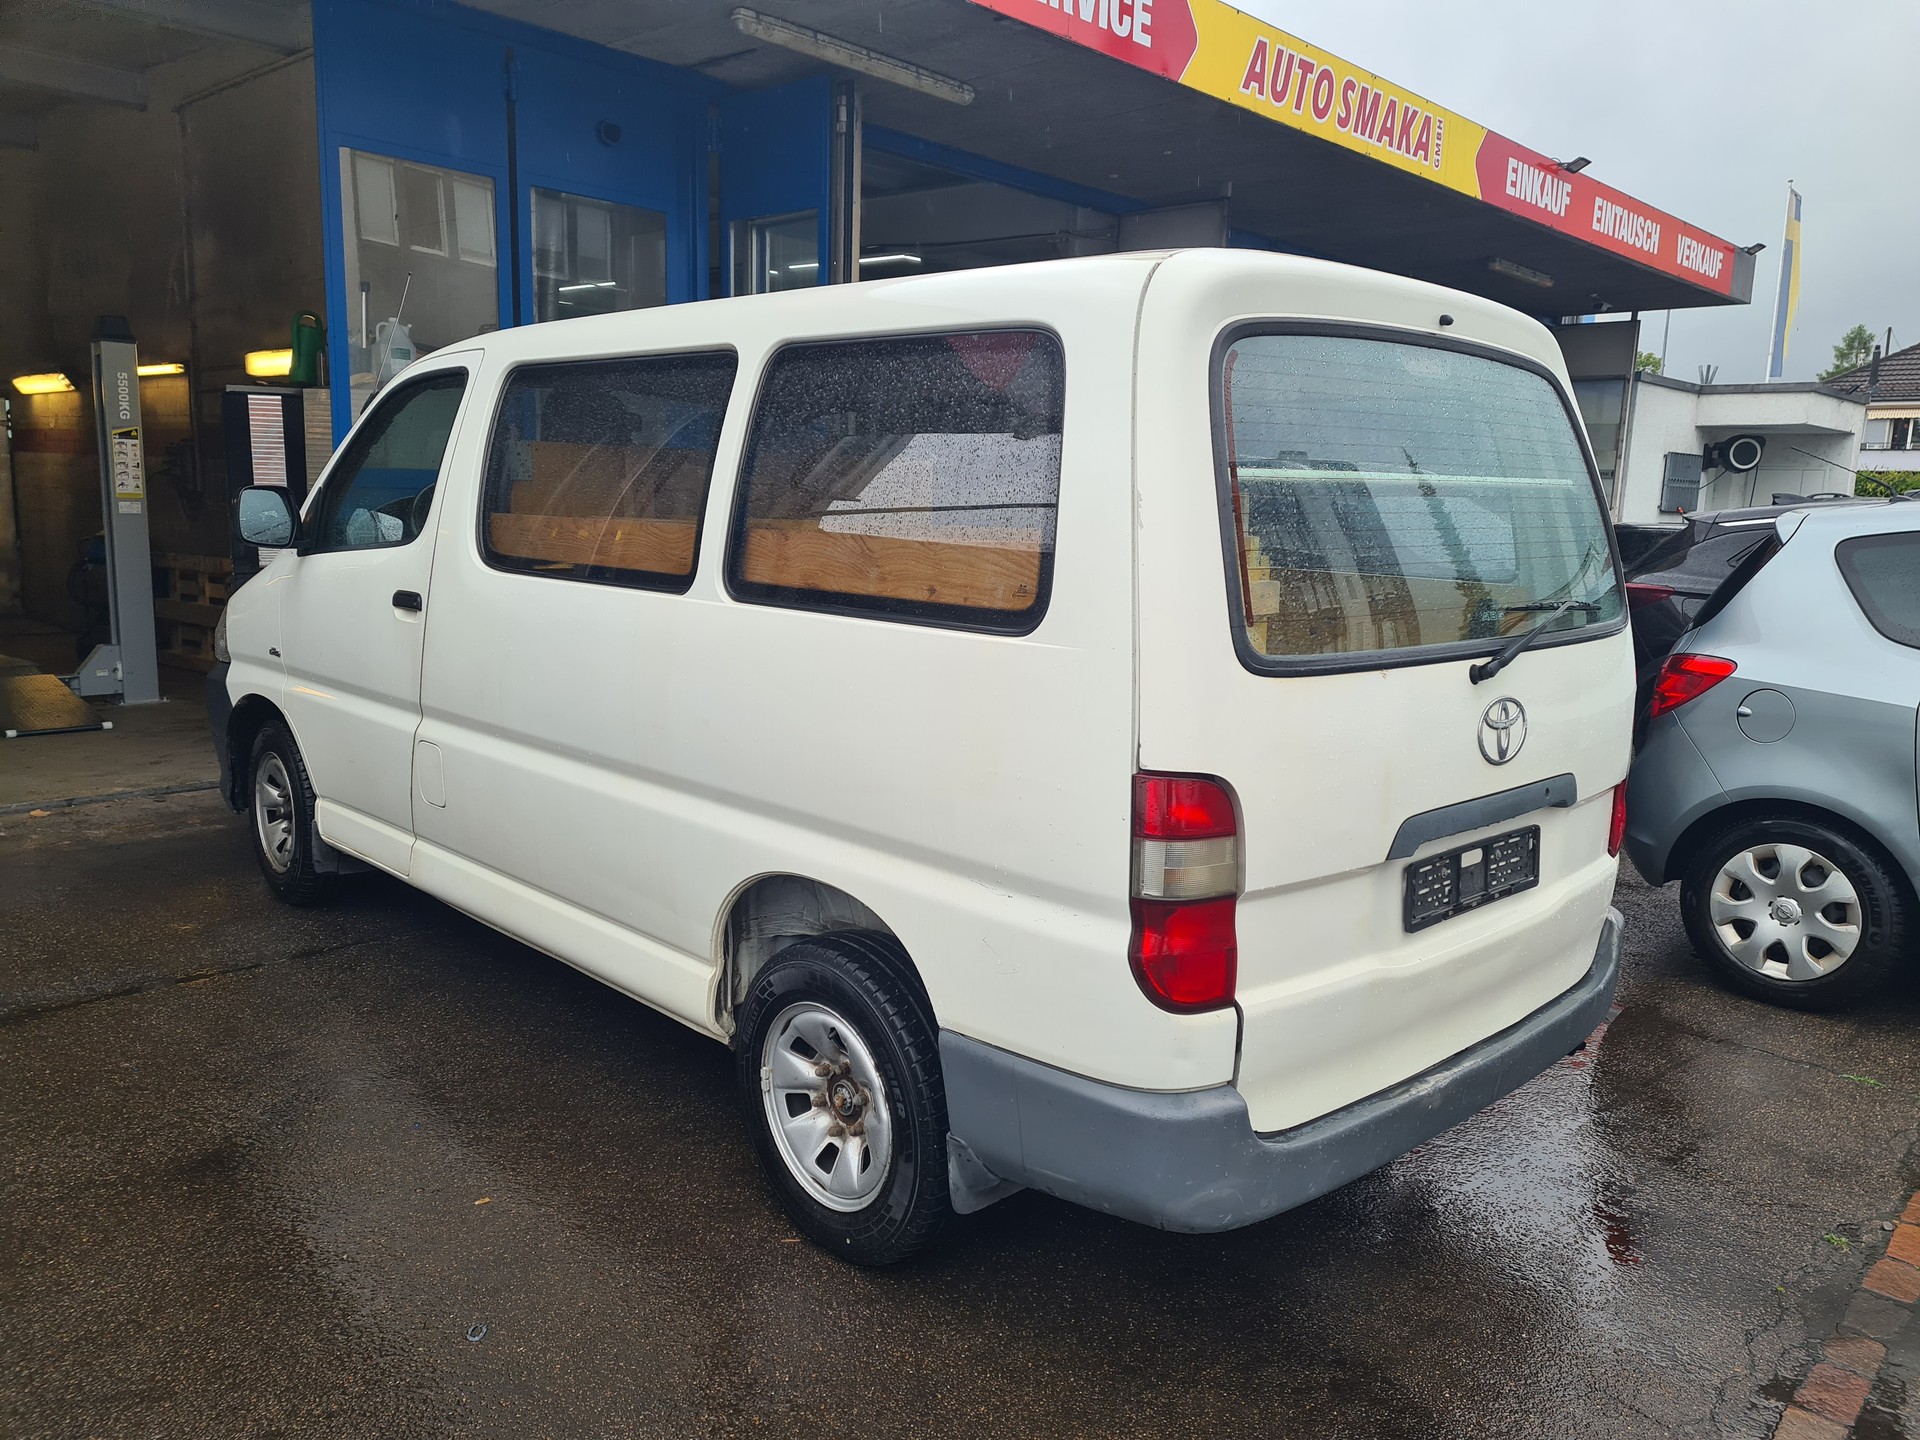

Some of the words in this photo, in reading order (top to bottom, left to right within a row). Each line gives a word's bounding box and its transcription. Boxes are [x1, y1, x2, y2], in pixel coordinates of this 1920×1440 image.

[1240, 36, 1335, 122] AUTO
[1336, 77, 1433, 164] SMAKA
[1433, 117, 1444, 169] GMBH
[1505, 157, 1572, 217] EINKAUF
[1592, 196, 1661, 255] EINTAUSCH
[1676, 234, 1724, 279] VERKAUF
[117, 372, 130, 420] 5500KG
